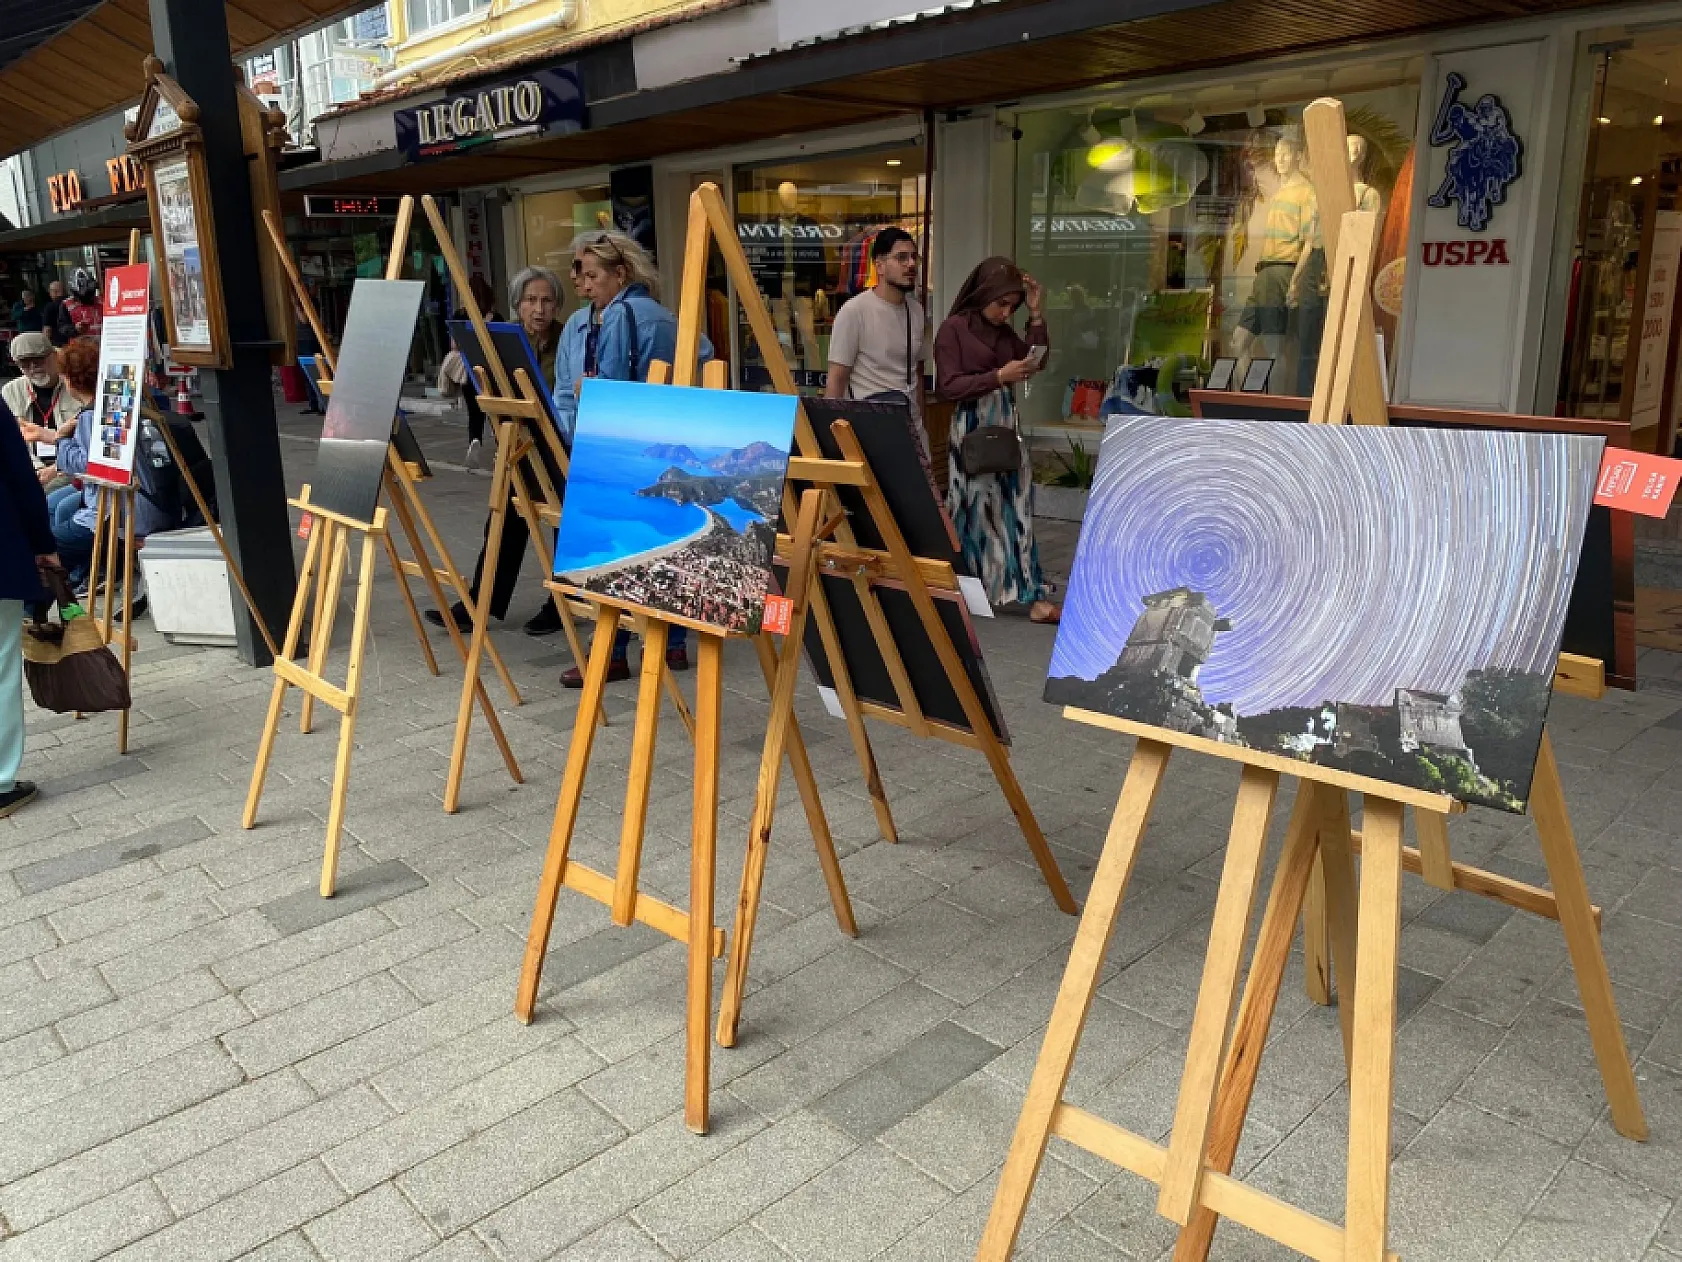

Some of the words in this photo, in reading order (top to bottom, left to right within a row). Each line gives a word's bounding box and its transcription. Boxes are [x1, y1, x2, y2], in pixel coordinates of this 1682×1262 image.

[416, 80, 543, 145] LEGATO
[46, 168, 81, 214] FLO
[1421, 238, 1510, 266] USPA
